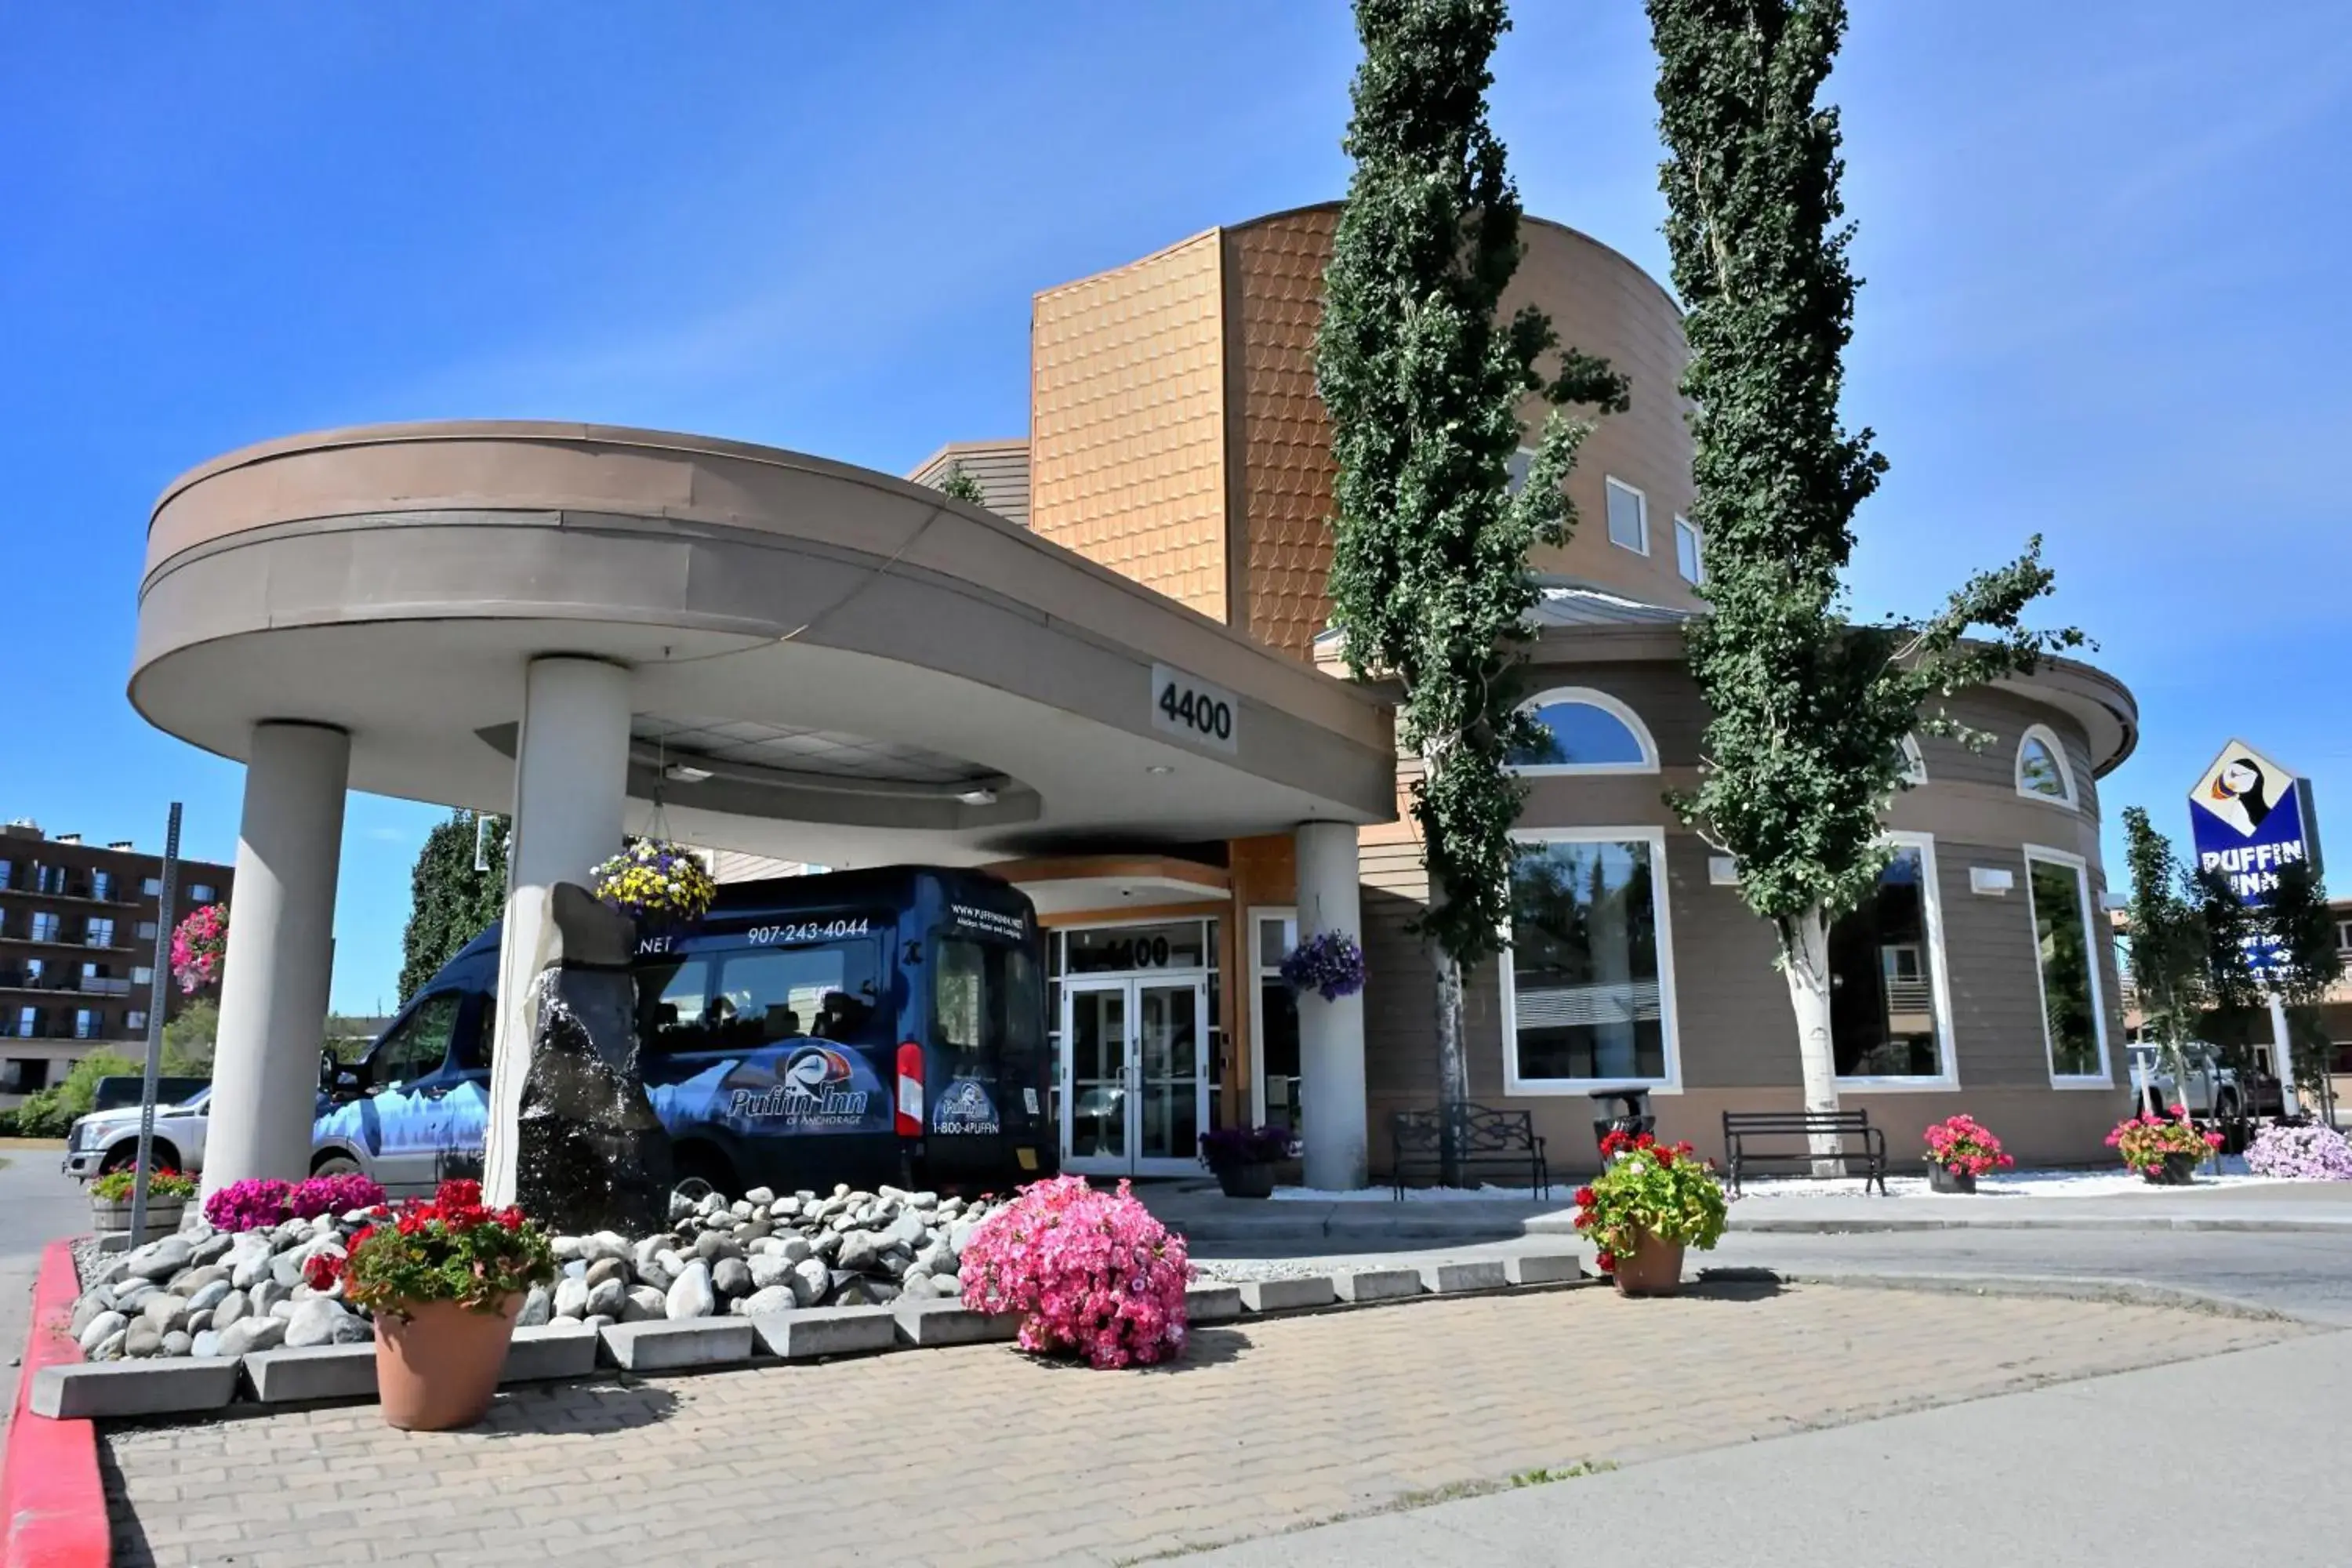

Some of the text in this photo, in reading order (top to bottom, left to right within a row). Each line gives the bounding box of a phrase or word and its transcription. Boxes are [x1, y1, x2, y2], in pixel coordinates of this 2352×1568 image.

[1160, 682, 1231, 740] 4400
[2201, 840, 2303, 873] PUFFIN
[748, 918, 869, 944] 907-243-4044
[726, 1080, 868, 1117] Puffin Inn
